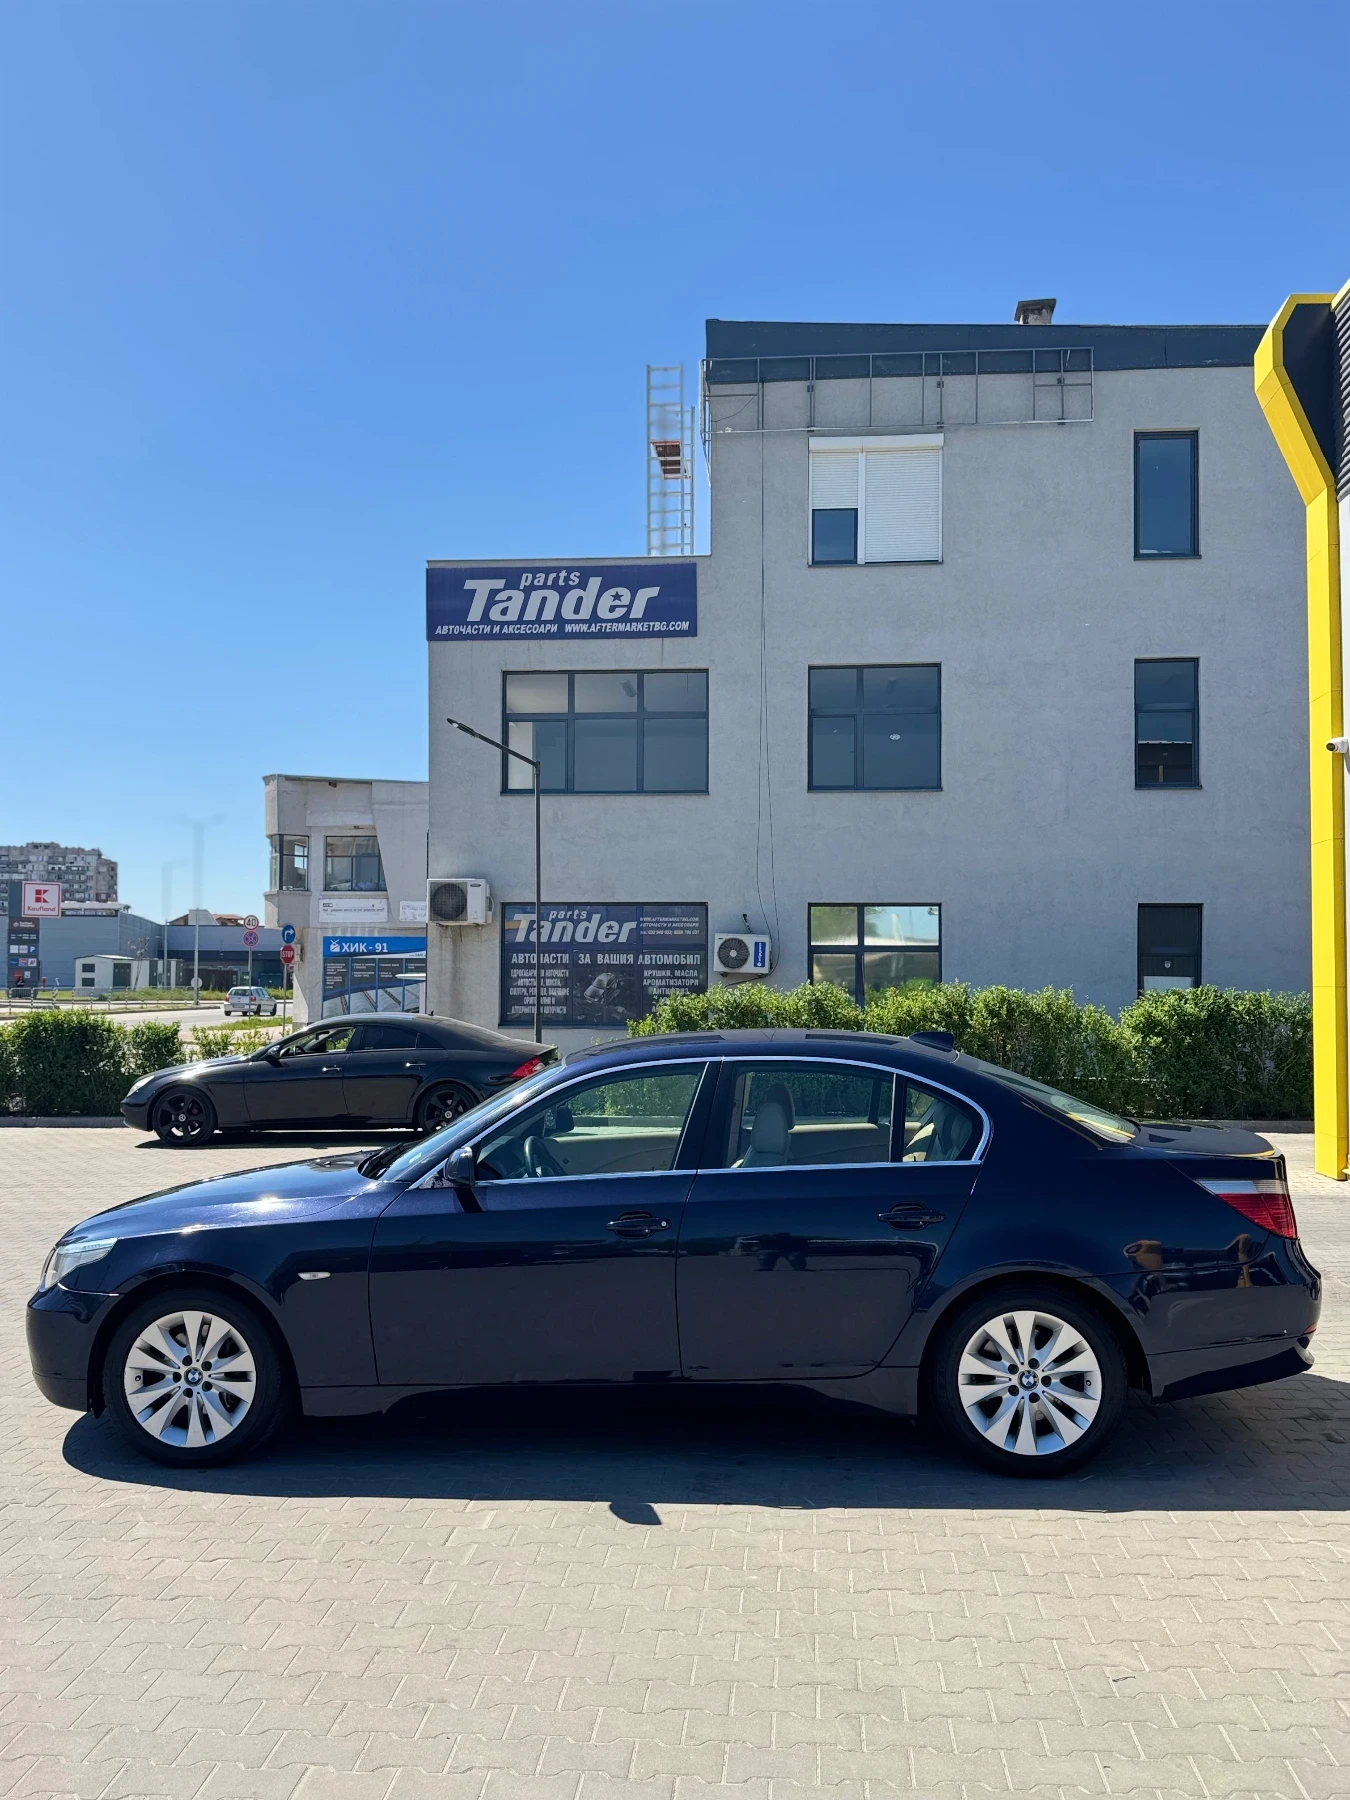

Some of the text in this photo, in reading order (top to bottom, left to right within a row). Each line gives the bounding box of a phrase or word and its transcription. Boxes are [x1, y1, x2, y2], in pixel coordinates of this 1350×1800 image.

[520, 570, 581, 590] parts
[463, 577, 661, 622] Tander
[435, 621, 690, 635] АВТОЧАСТИ И АКСЕСОАРИ WWW.AFTERMARKETBG.COM
[549, 909, 588, 921] parts
[246, 918, 257, 927] 40
[512, 914, 638, 943] Tander
[342, 943, 367, 953] ХИК
[375, 943, 388, 953] 91
[282, 950, 294, 958] STOP
[511, 953, 701, 965] АВТОАСТИ ЗА ВАШИЯ АВТОМОБИЛ
[511, 969, 544, 978] ЕДРОГАБАРИИ
[644, 970, 673, 978] КРУШКИ,
[517, 978, 545, 986] АВТОСТЪА,
